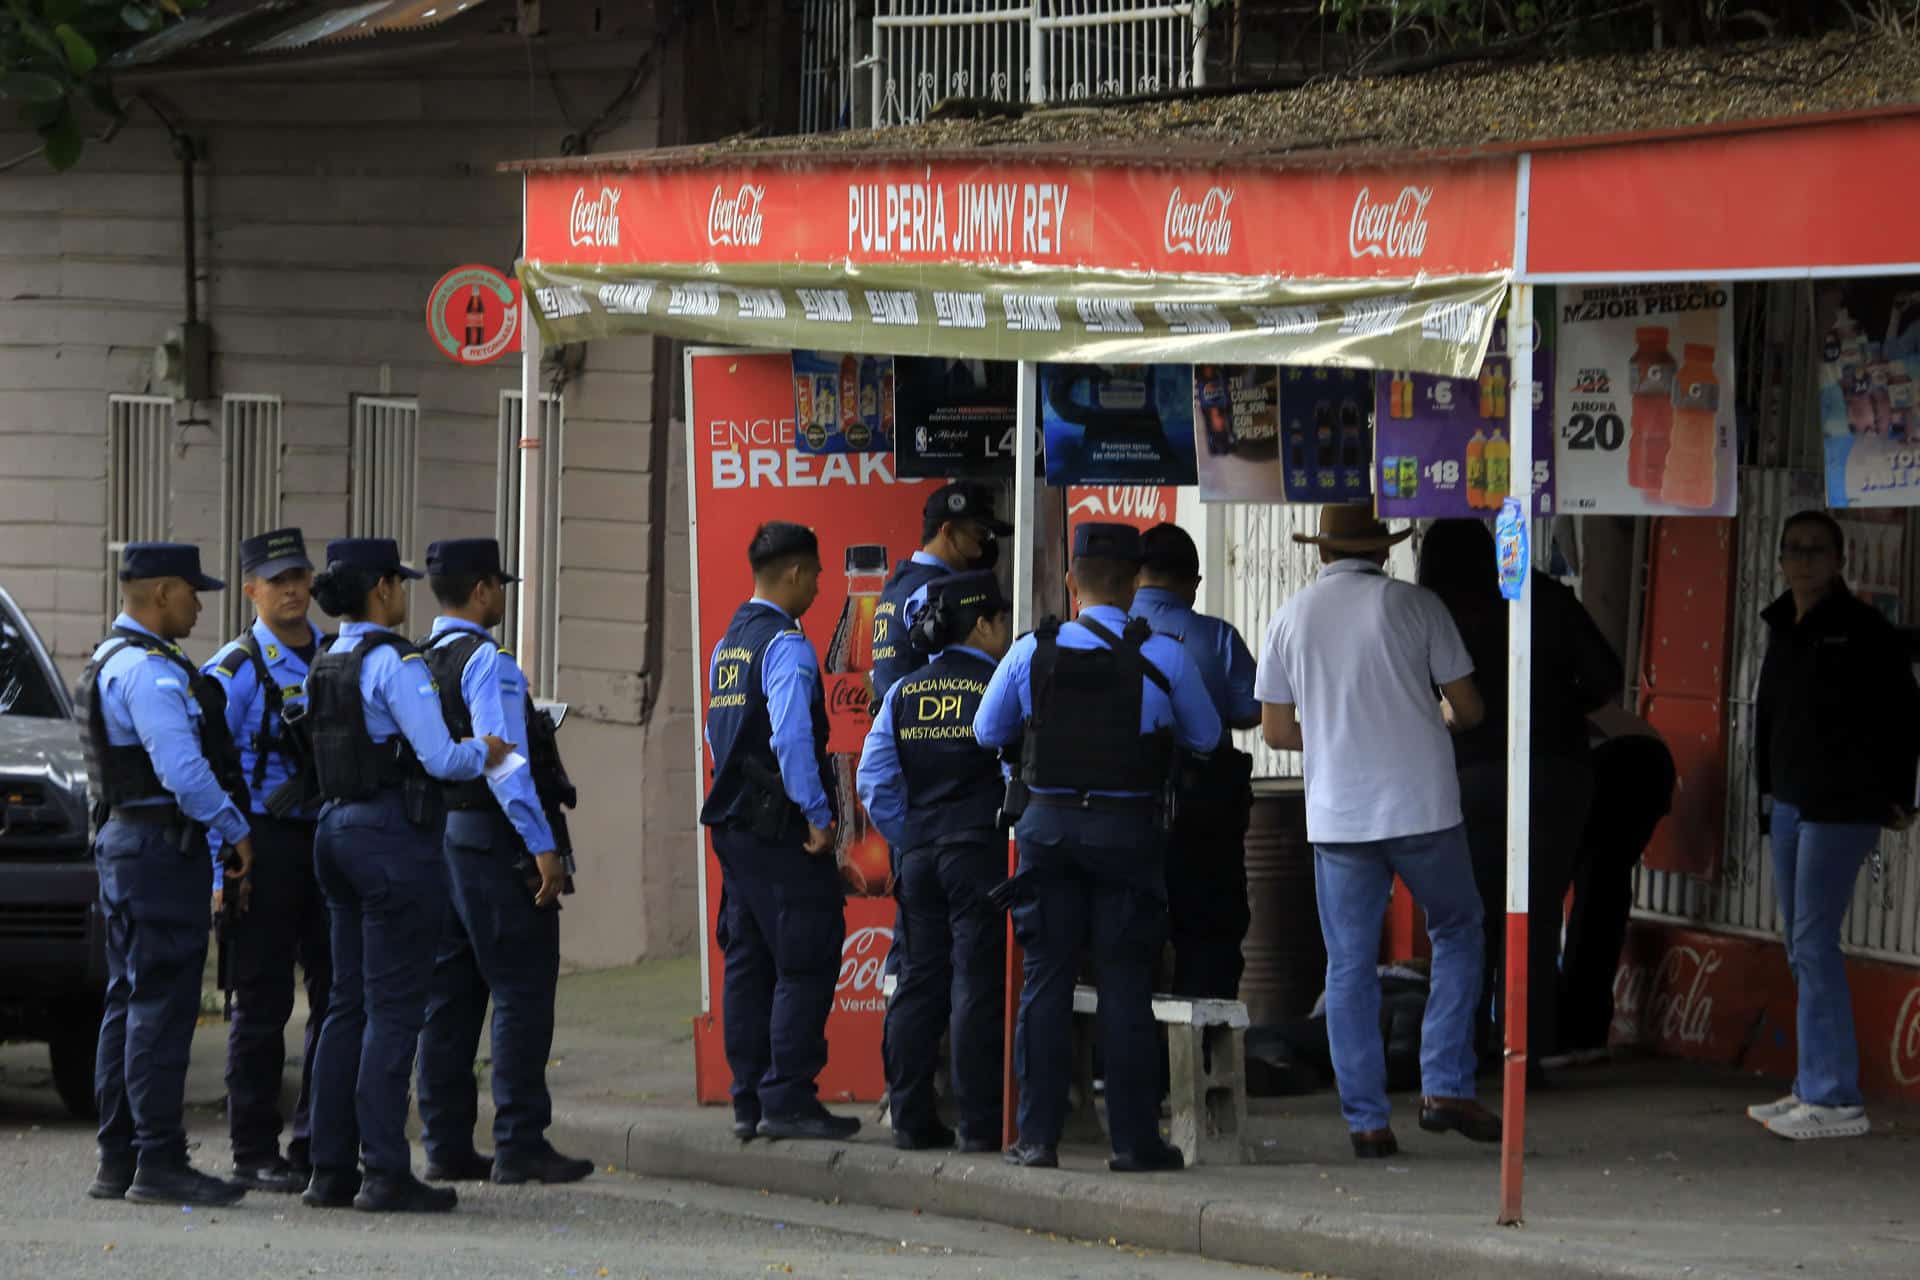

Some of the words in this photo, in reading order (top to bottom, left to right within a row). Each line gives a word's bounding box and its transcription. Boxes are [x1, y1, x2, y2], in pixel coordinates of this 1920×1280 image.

[569, 186, 623, 248] Coca-Cola
[707, 184, 767, 248] Coca-Cola
[848, 166, 946, 252] PULPERÍA
[953, 183, 1018, 253] JIMMY
[1023, 183, 1069, 255] REY
[1163, 185, 1233, 256] Coca-Cola
[1348, 185, 1434, 259] Coca-Cola
[710, 418, 795, 447] ENCIE
[718, 663, 739, 690] DPI
[901, 680, 938, 698] POLICIA
[938, 677, 987, 695] NACIONAL
[918, 695, 962, 721] DPI
[840, 995, 887, 1012] Verda
